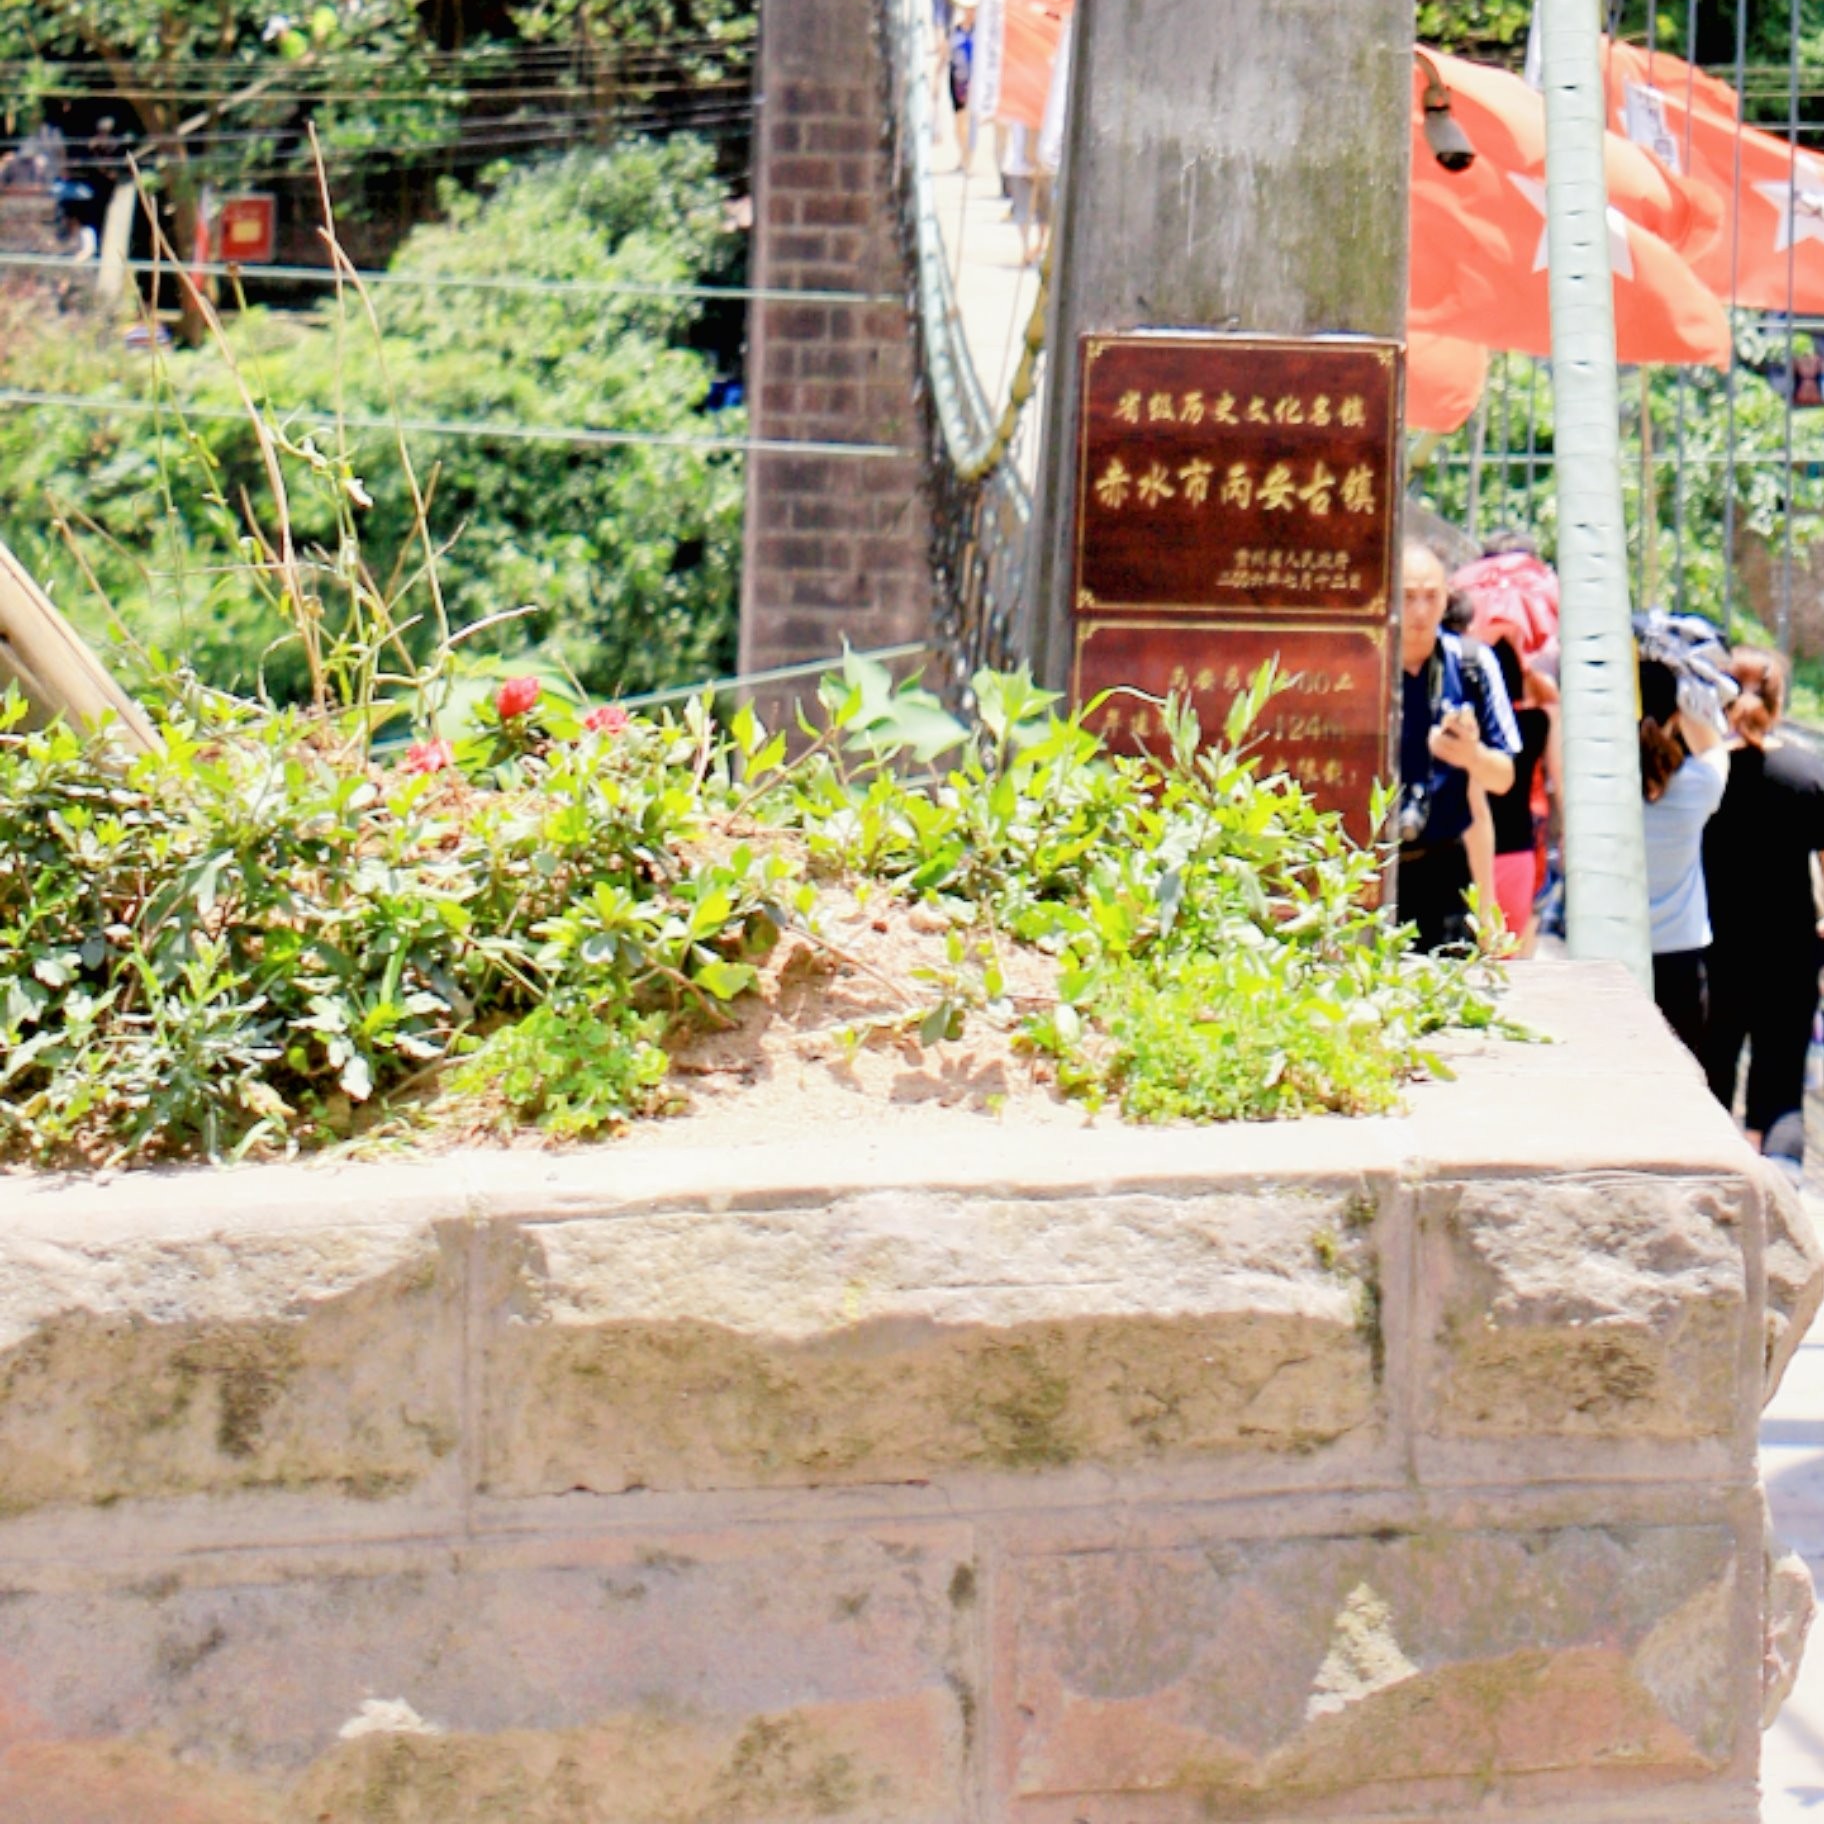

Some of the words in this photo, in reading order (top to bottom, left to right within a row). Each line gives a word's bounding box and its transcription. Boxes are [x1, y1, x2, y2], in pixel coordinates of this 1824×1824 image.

[1112, 389, 1366, 429] 省级历史文化名镇
[1095, 457, 1377, 516] 赤水市丙安古镇
